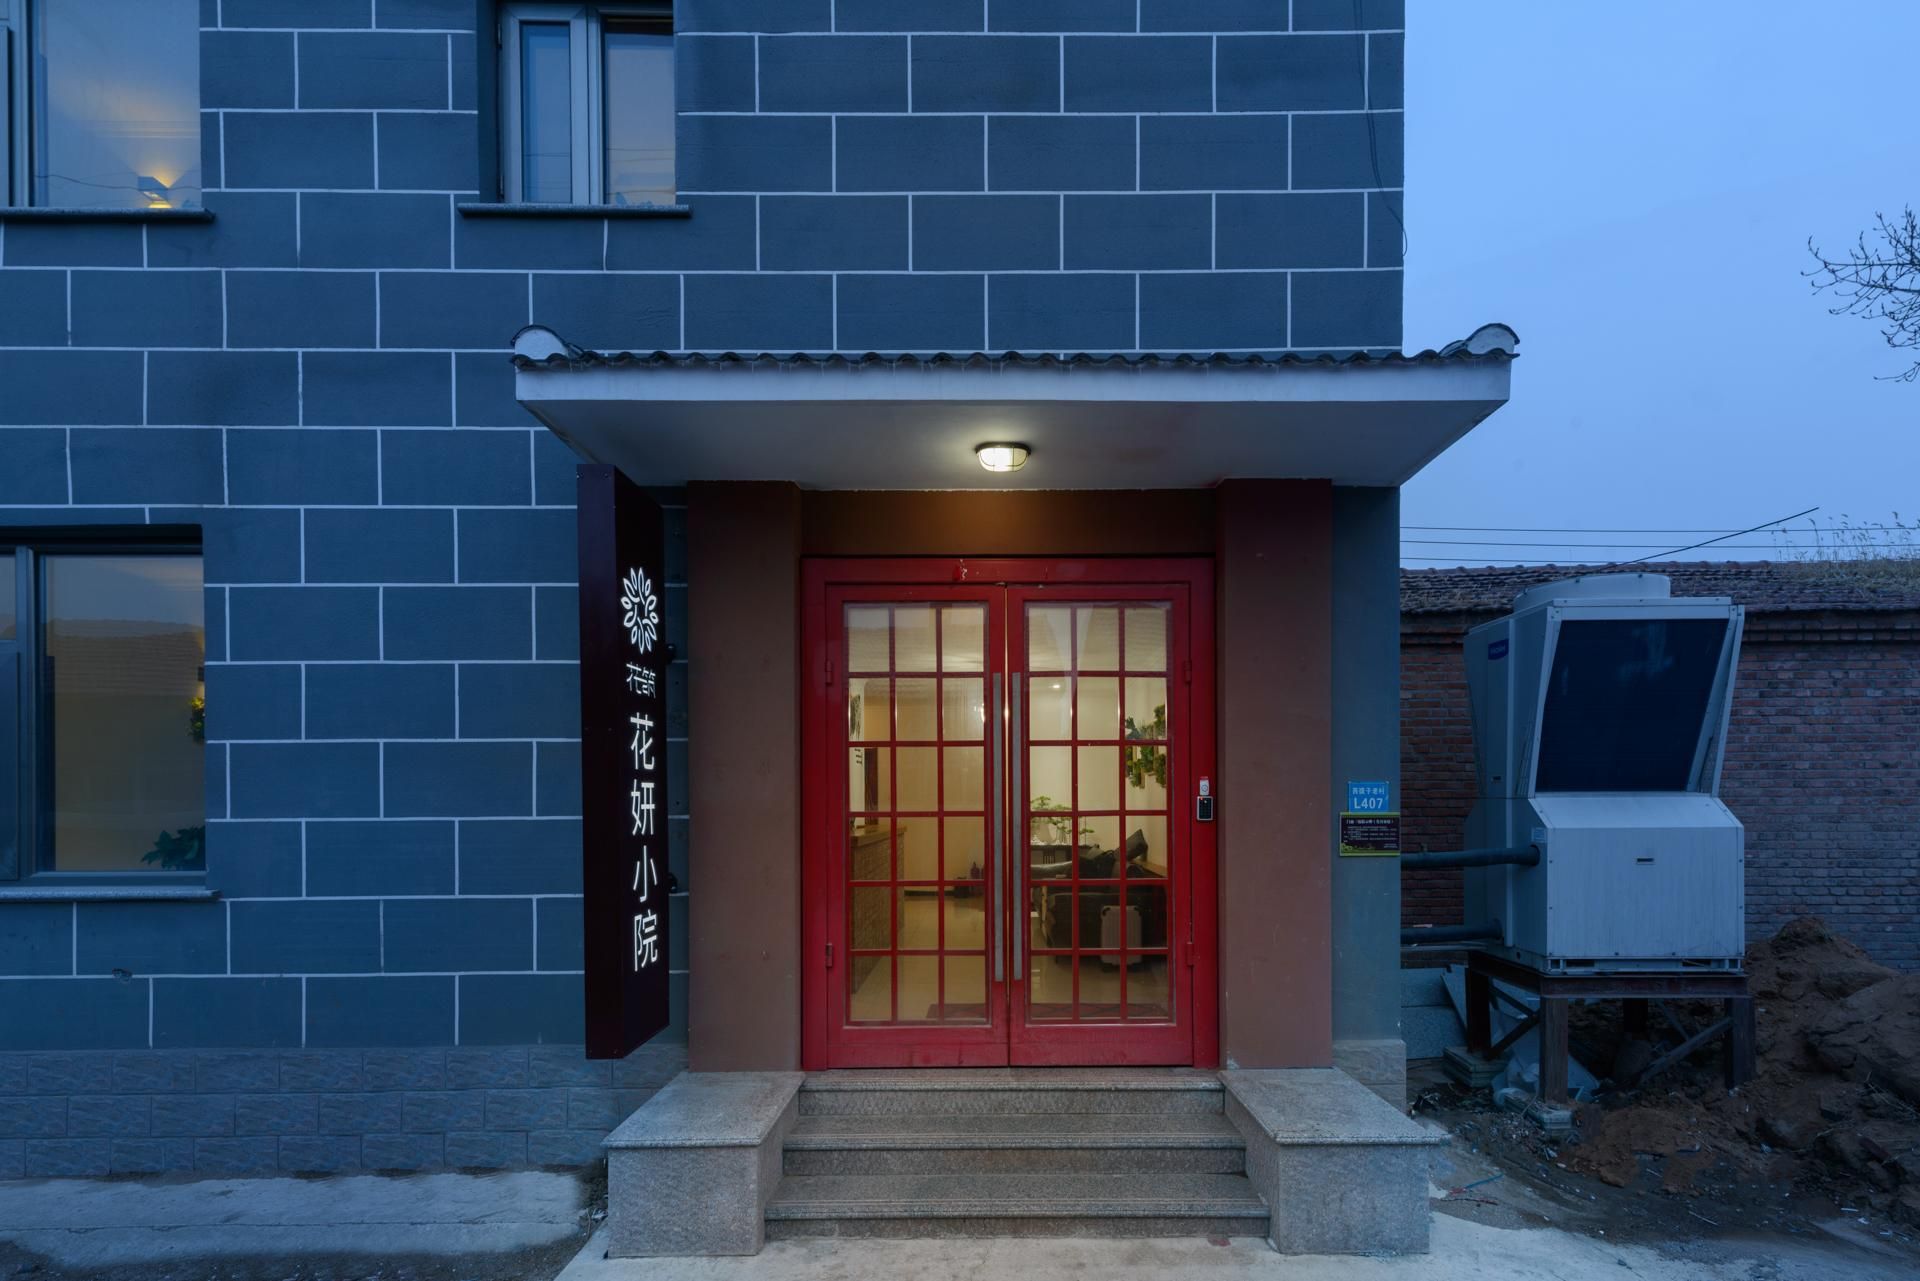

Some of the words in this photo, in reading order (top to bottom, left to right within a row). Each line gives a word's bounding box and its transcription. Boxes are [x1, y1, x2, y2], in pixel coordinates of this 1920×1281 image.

[625, 661, 656, 699] 花筑
[1353, 797, 1383, 809] L407
[629, 712, 659, 972] 花妍小院
